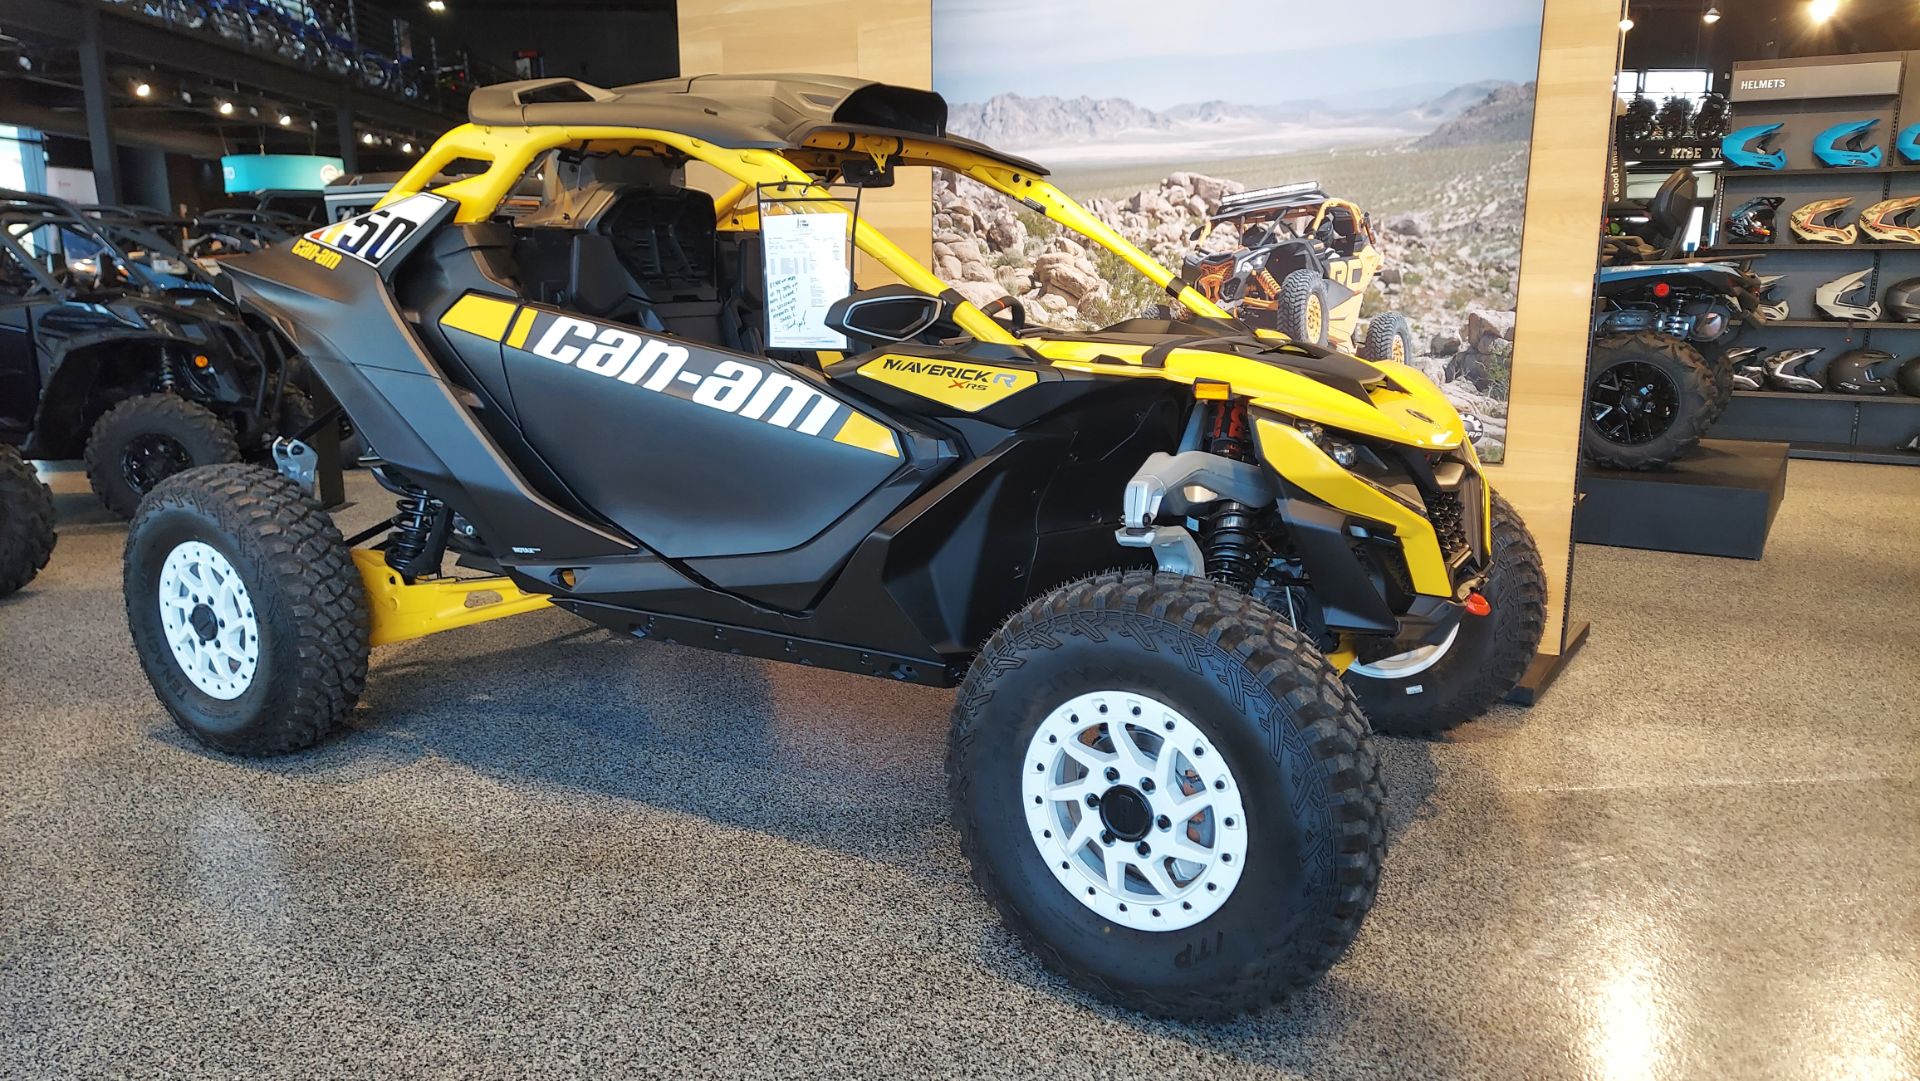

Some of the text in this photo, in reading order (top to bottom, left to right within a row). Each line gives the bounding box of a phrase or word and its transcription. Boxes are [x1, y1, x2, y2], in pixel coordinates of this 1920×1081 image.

[1741, 78, 1786, 90] HELMETS
[338, 210, 418, 264] 50
[291, 238, 343, 270] can-am
[532, 315, 841, 436] can-am
[883, 358, 994, 383] MAVERICK
[948, 379, 989, 391] XRS
[1174, 929, 1224, 969] ITP
